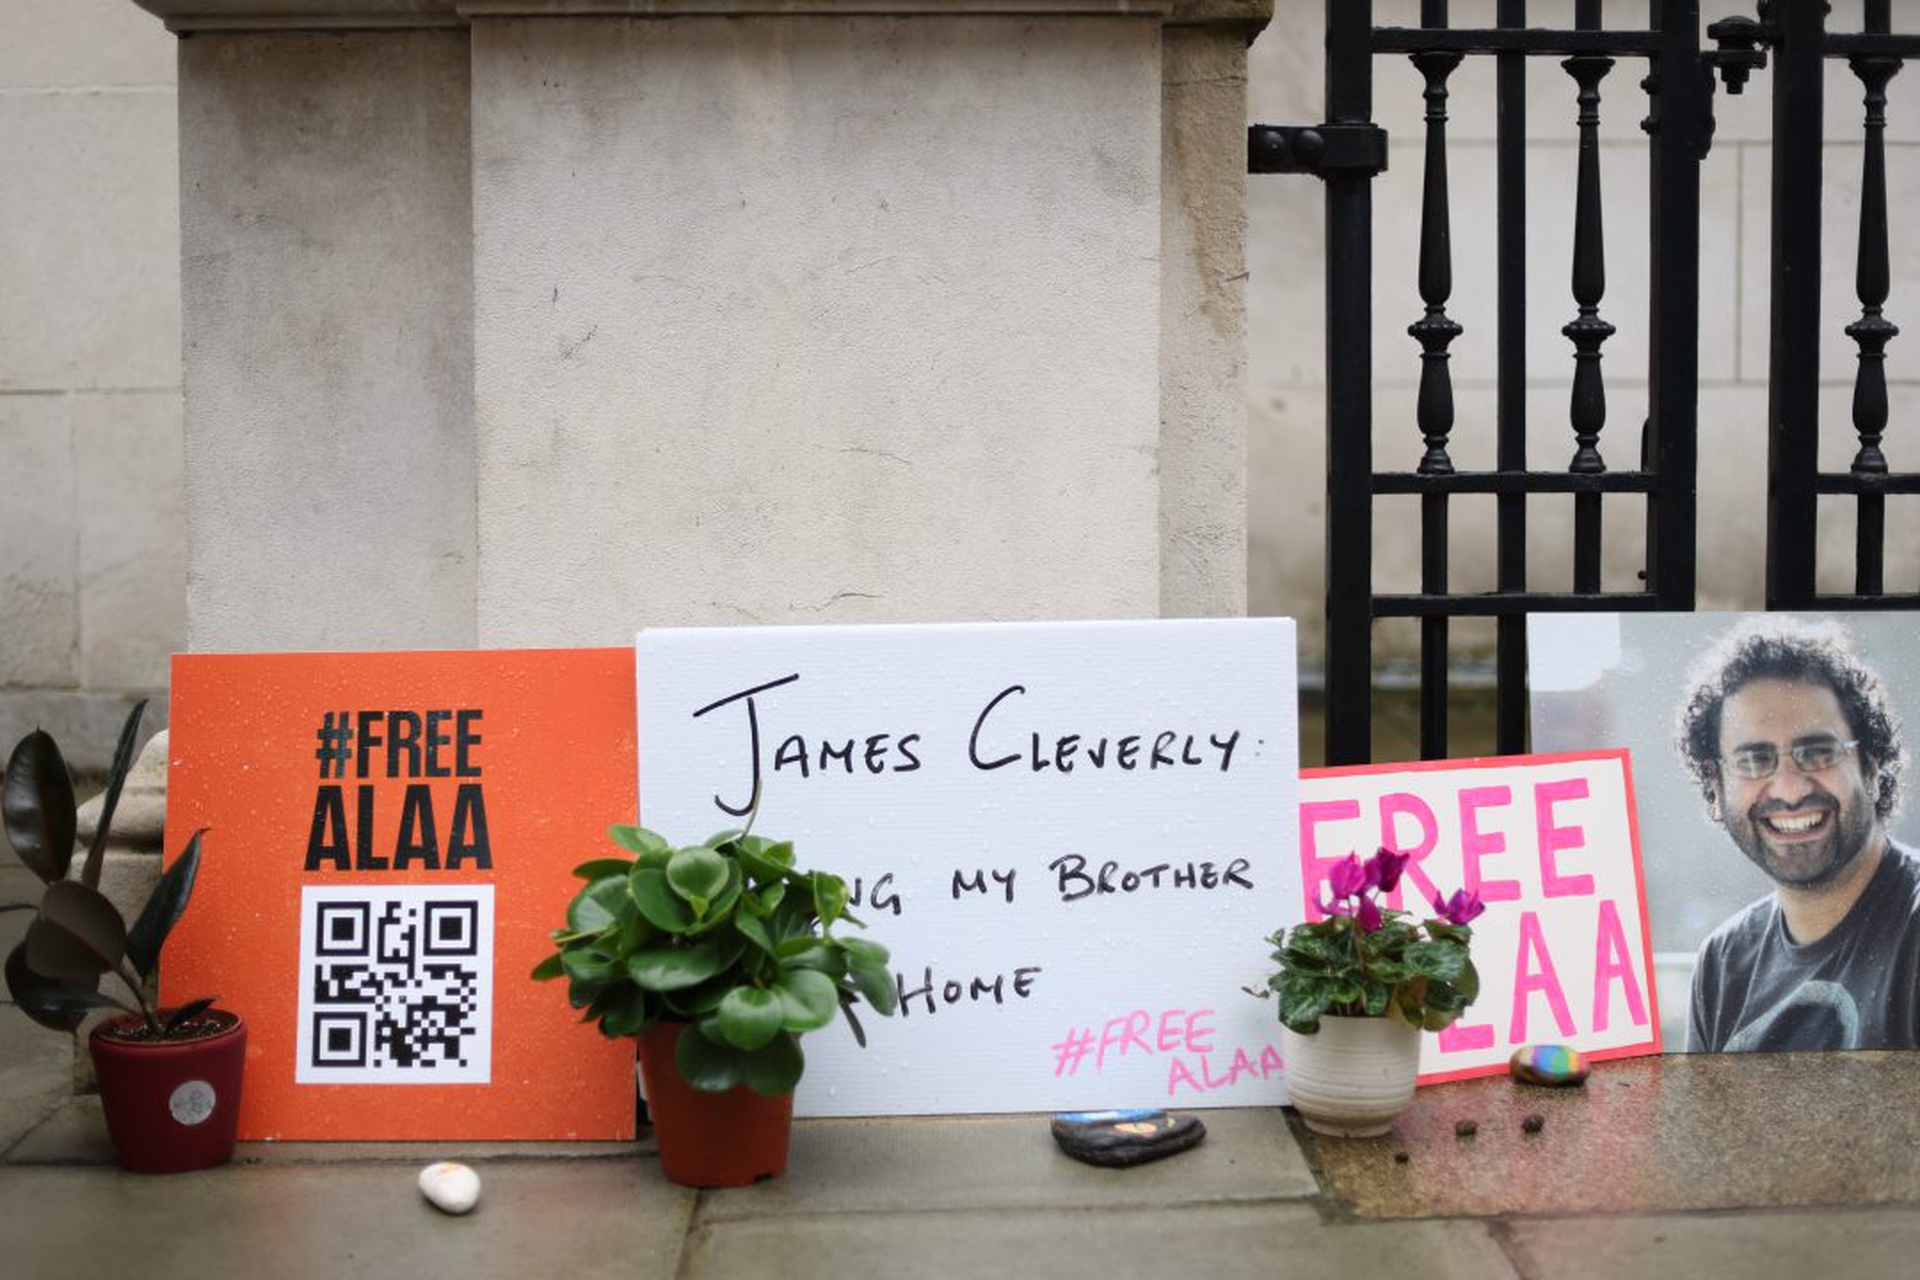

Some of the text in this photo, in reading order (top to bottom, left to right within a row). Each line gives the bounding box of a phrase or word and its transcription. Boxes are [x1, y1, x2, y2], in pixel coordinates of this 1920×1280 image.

[316, 709, 484, 779] #FREE
[692, 673, 921, 816] JAMES
[304, 783, 494, 871] ALAA
[1299, 778, 1595, 924] FREE
[951, 868, 1016, 903] MY
[1049, 854, 1254, 902] BROTHER
[896, 966, 1042, 1018] HOME
[1052, 1009, 1216, 1078] #FREE
[1167, 1044, 1284, 1096] ALAA
